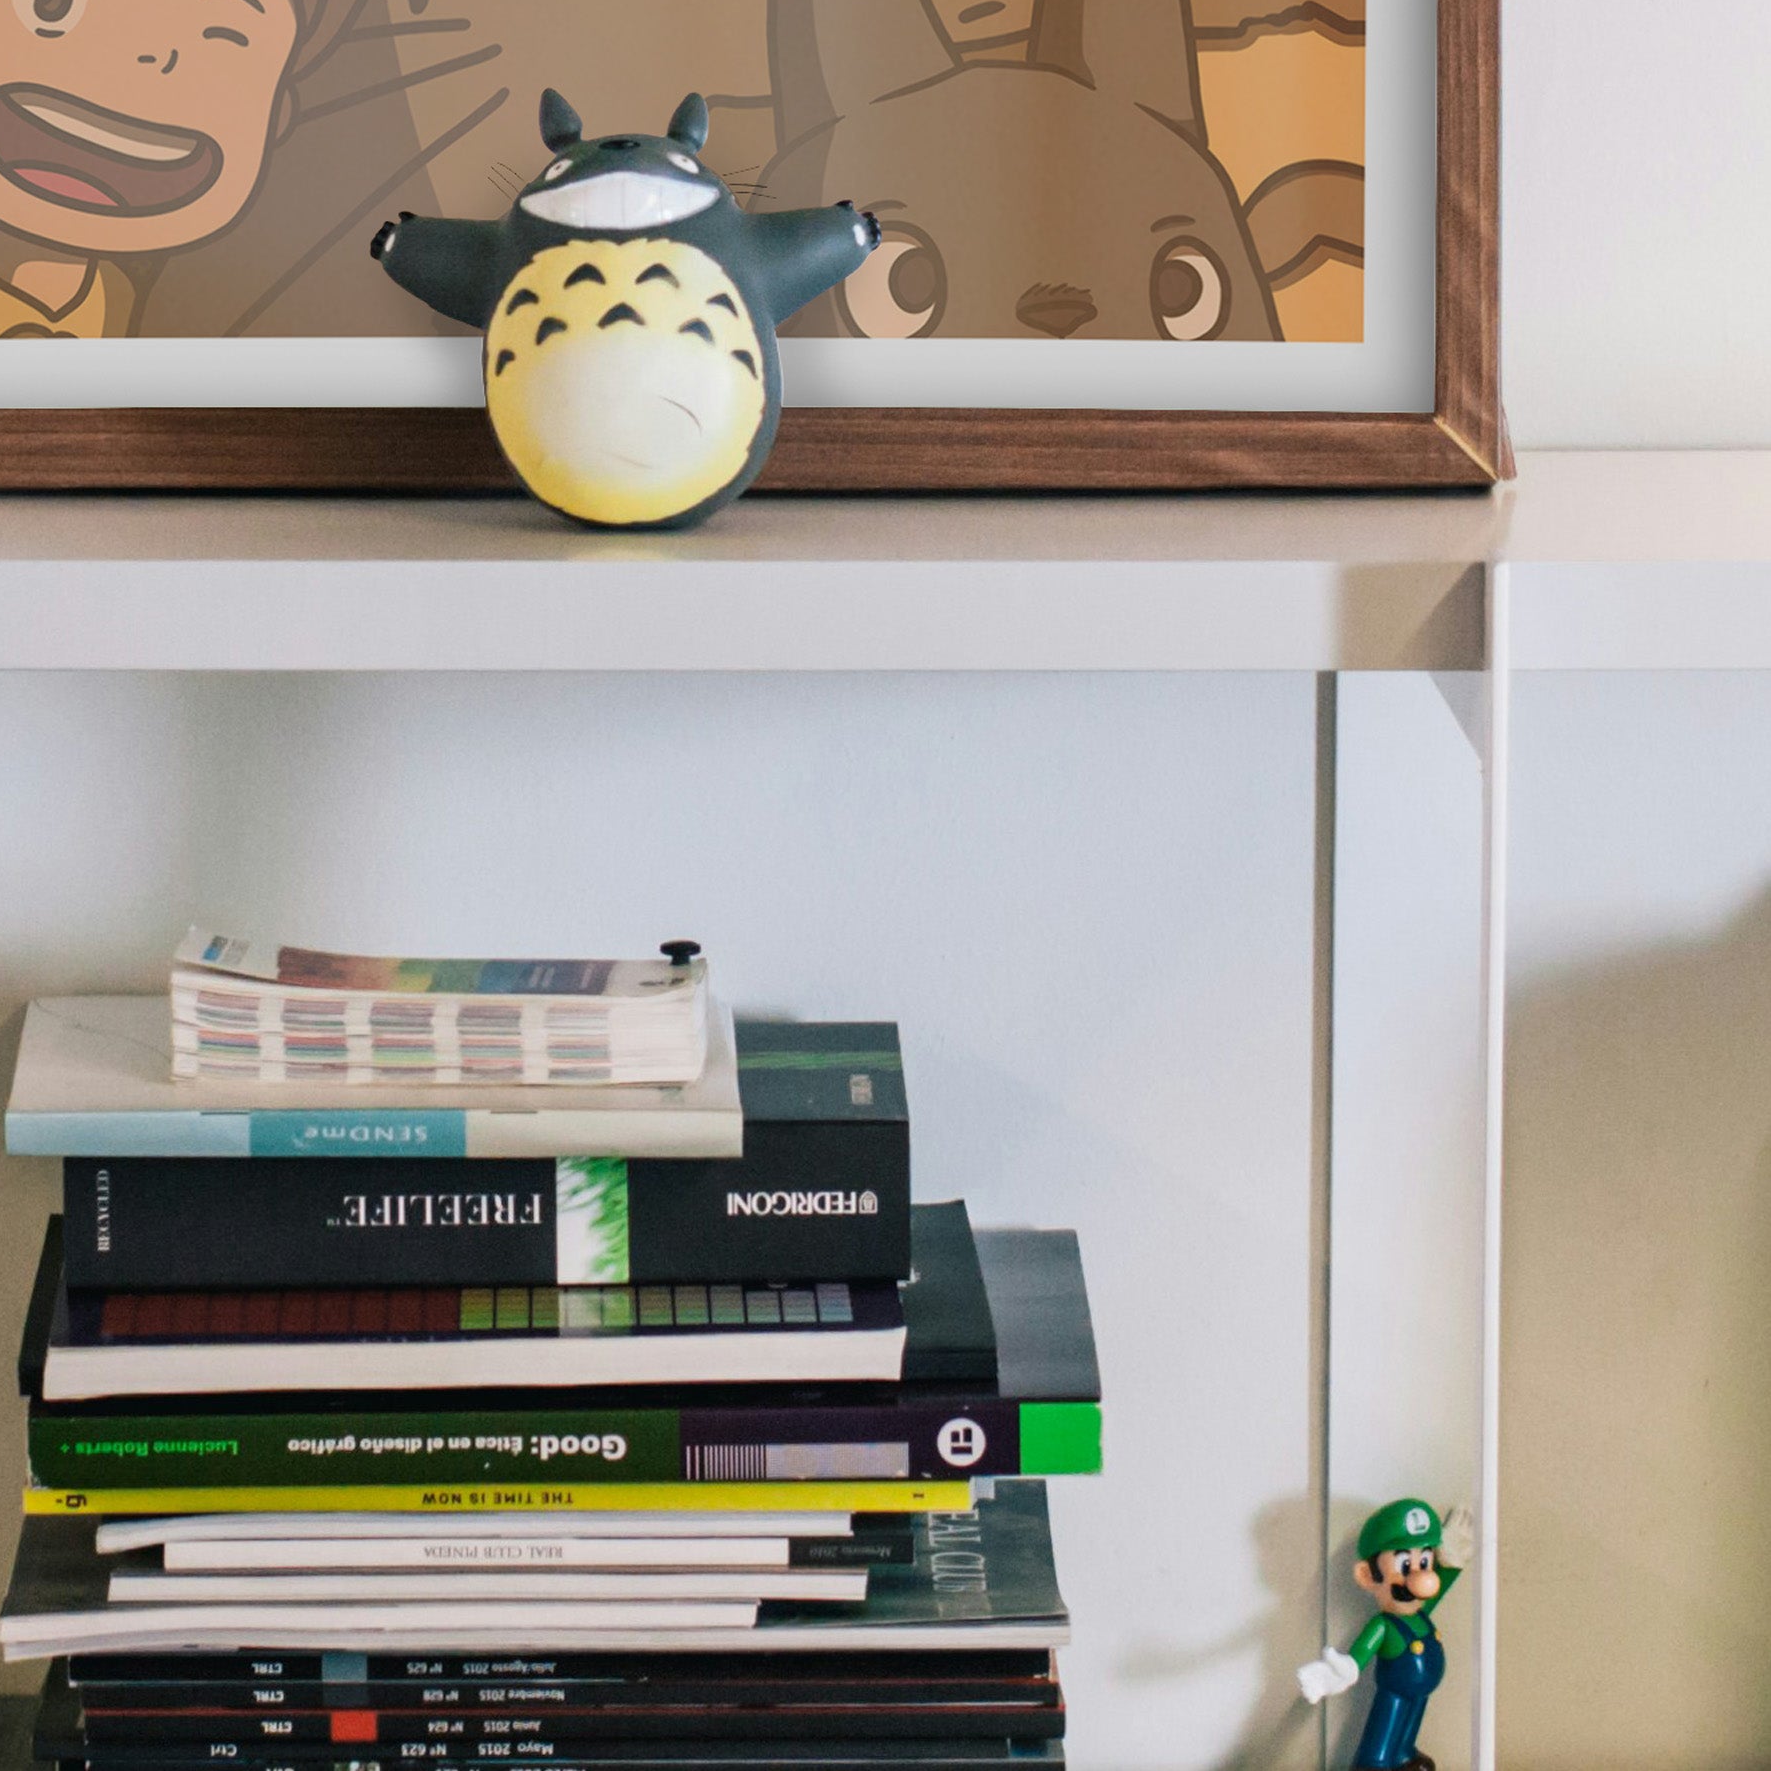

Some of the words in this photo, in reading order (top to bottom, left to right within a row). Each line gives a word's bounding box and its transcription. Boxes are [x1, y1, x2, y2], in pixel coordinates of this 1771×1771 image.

[344, 1193, 542, 1226] FREELIFE
[728, 1191, 856, 1215] FEDRIGONI
[96, 1170, 111, 1252] RECYCLED
[74, 1439, 149, 1457] Roberts
[154, 1439, 239, 1456] Lucienne
[287, 1434, 356, 1454] gráfico
[360, 1437, 422, 1455] diseño
[426, 1437, 444, 1453] el
[447, 1436, 471, 1450] en
[475, 1435, 523, 1455] Ética
[529, 1435, 627, 1462] Good:
[421, 1491, 461, 1505] NOW
[469, 1491, 486, 1504] IS
[492, 1491, 533, 1504] TIME
[539, 1491, 574, 1504] THE
[423, 1546, 479, 1559] PINEDA
[483, 1546, 523, 1559] CLUB
[526, 1546, 564, 1559] REAL
[254, 1690, 284, 1702] CTRL
[261, 1721, 293, 1733] CTRL
[210, 1744, 237, 1756] Ctrl
[401, 1743, 426, 1756] 623
[477, 1743, 511, 1756] 2015
[517, 1742, 553, 1755] Mayo
